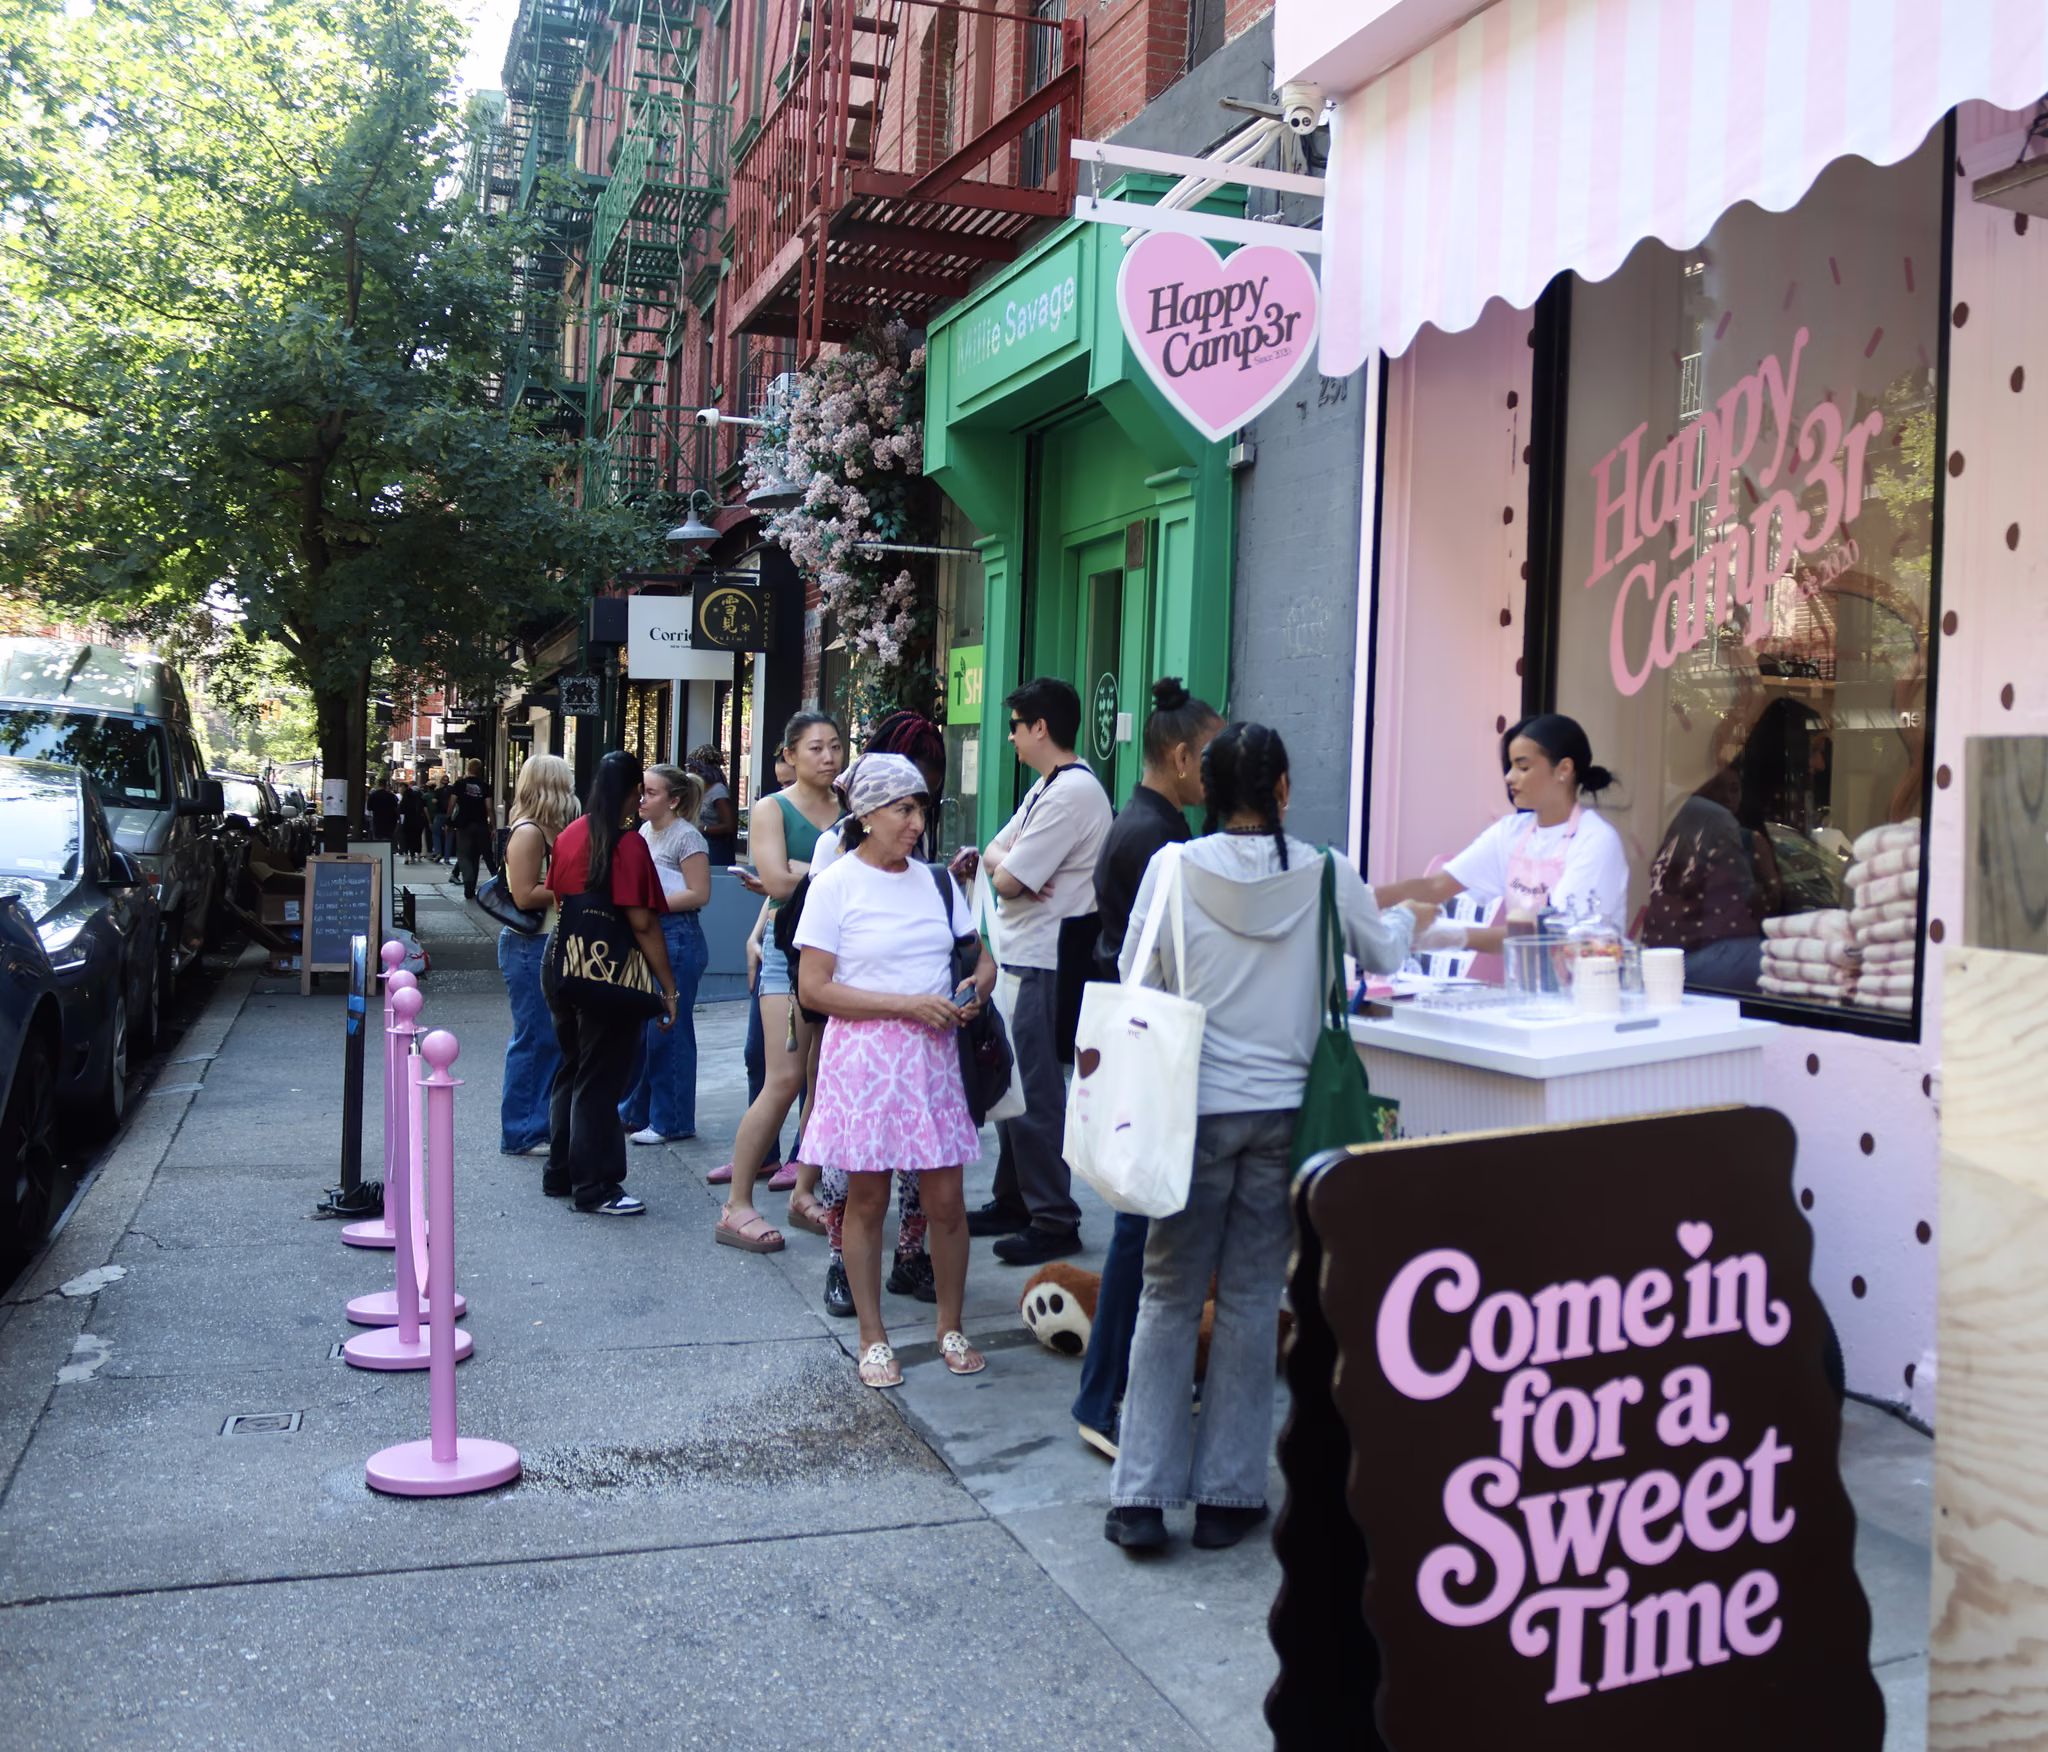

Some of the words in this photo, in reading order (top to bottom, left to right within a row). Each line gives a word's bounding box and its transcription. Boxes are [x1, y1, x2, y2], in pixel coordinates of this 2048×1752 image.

[957, 317, 1001, 377] Millie
[1005, 276, 1075, 347] Savage
[1146, 275, 1269, 335] Happy
[1162, 302, 1302, 378] Camp3r
[1585, 327, 1809, 588] Happy
[1609, 401, 1883, 696] Camp3r
[763, 592, 771, 648] OMAKASE
[1377, 1247, 1675, 1401] Come
[1677, 1220, 1791, 1347] in
[1492, 1366, 1644, 1472] for
[1656, 1365, 1730, 1447] a
[1416, 1426, 1796, 1628] Sweet
[1509, 1567, 1783, 1704] Time
